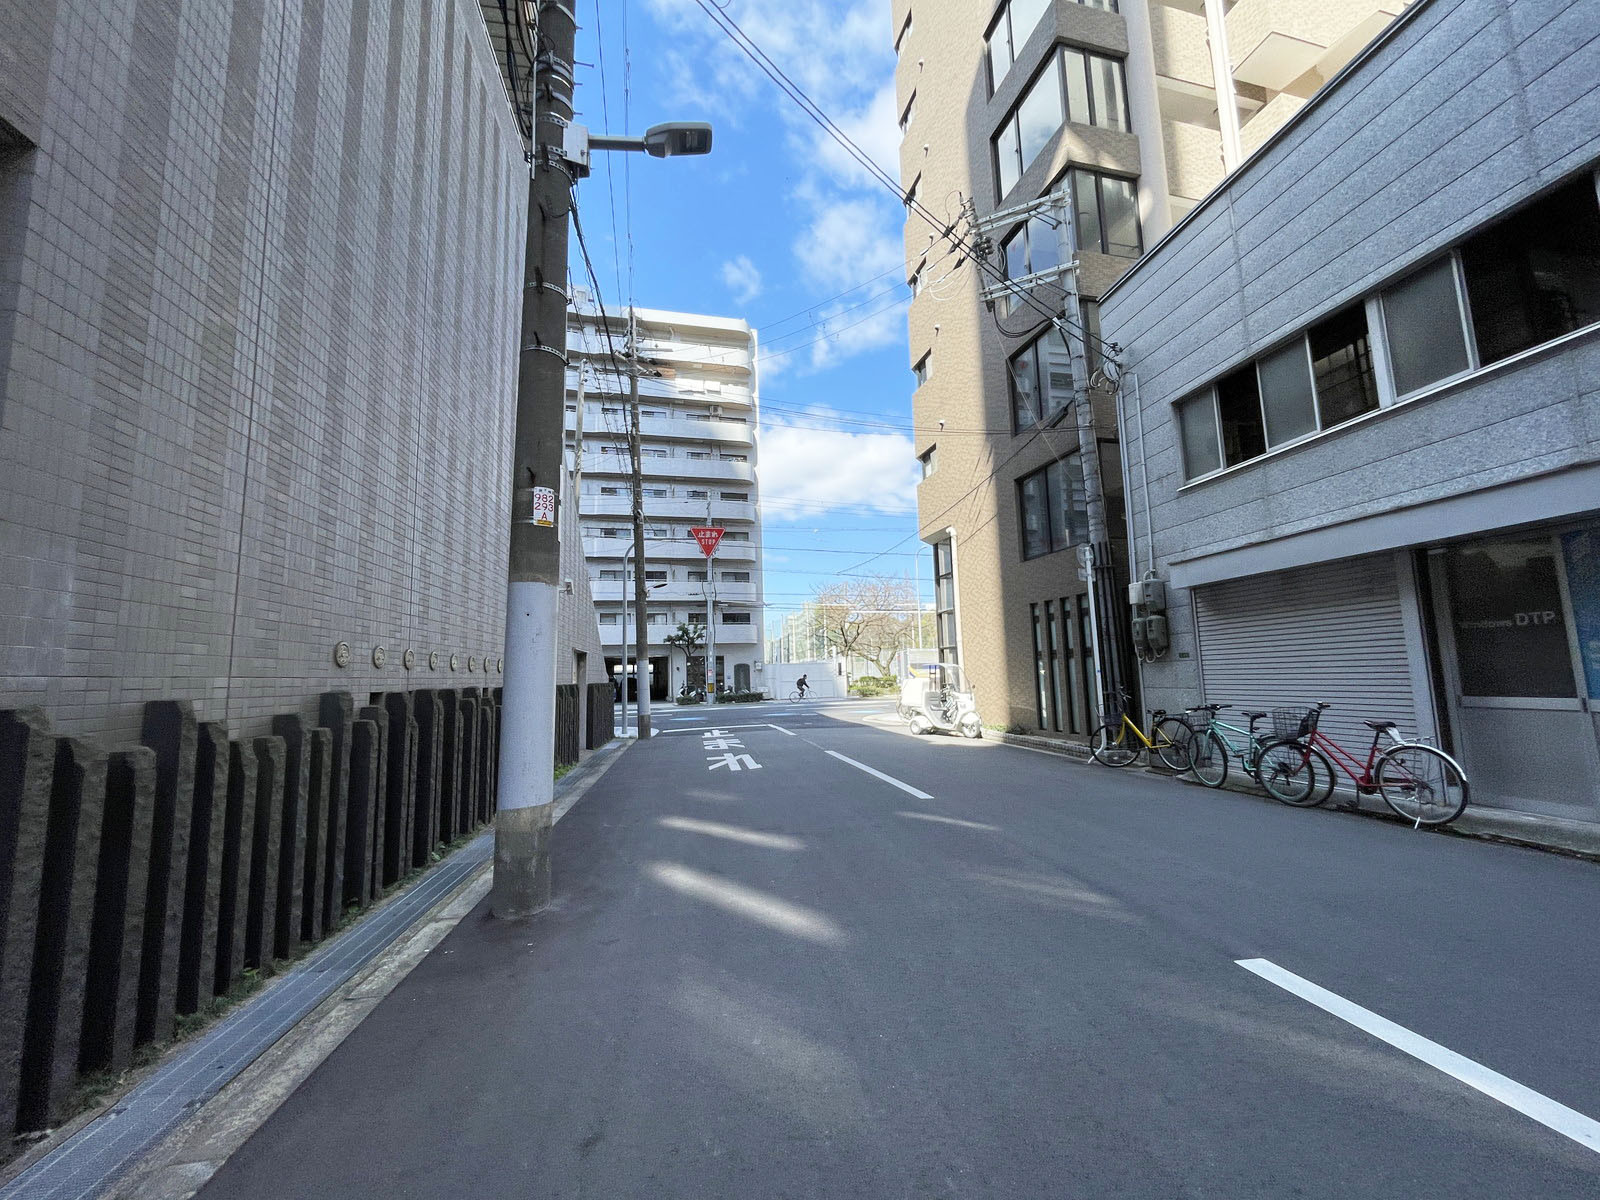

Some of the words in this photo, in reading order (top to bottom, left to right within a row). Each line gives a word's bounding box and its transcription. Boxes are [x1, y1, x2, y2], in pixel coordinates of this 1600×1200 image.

[534, 493, 554, 504] 982
[534, 502, 554, 512] 293
[541, 512, 548, 521] A
[697, 530, 719, 538] 止まれ
[1514, 610, 1555, 626] DTP
[702, 729, 763, 771] 止まれ
